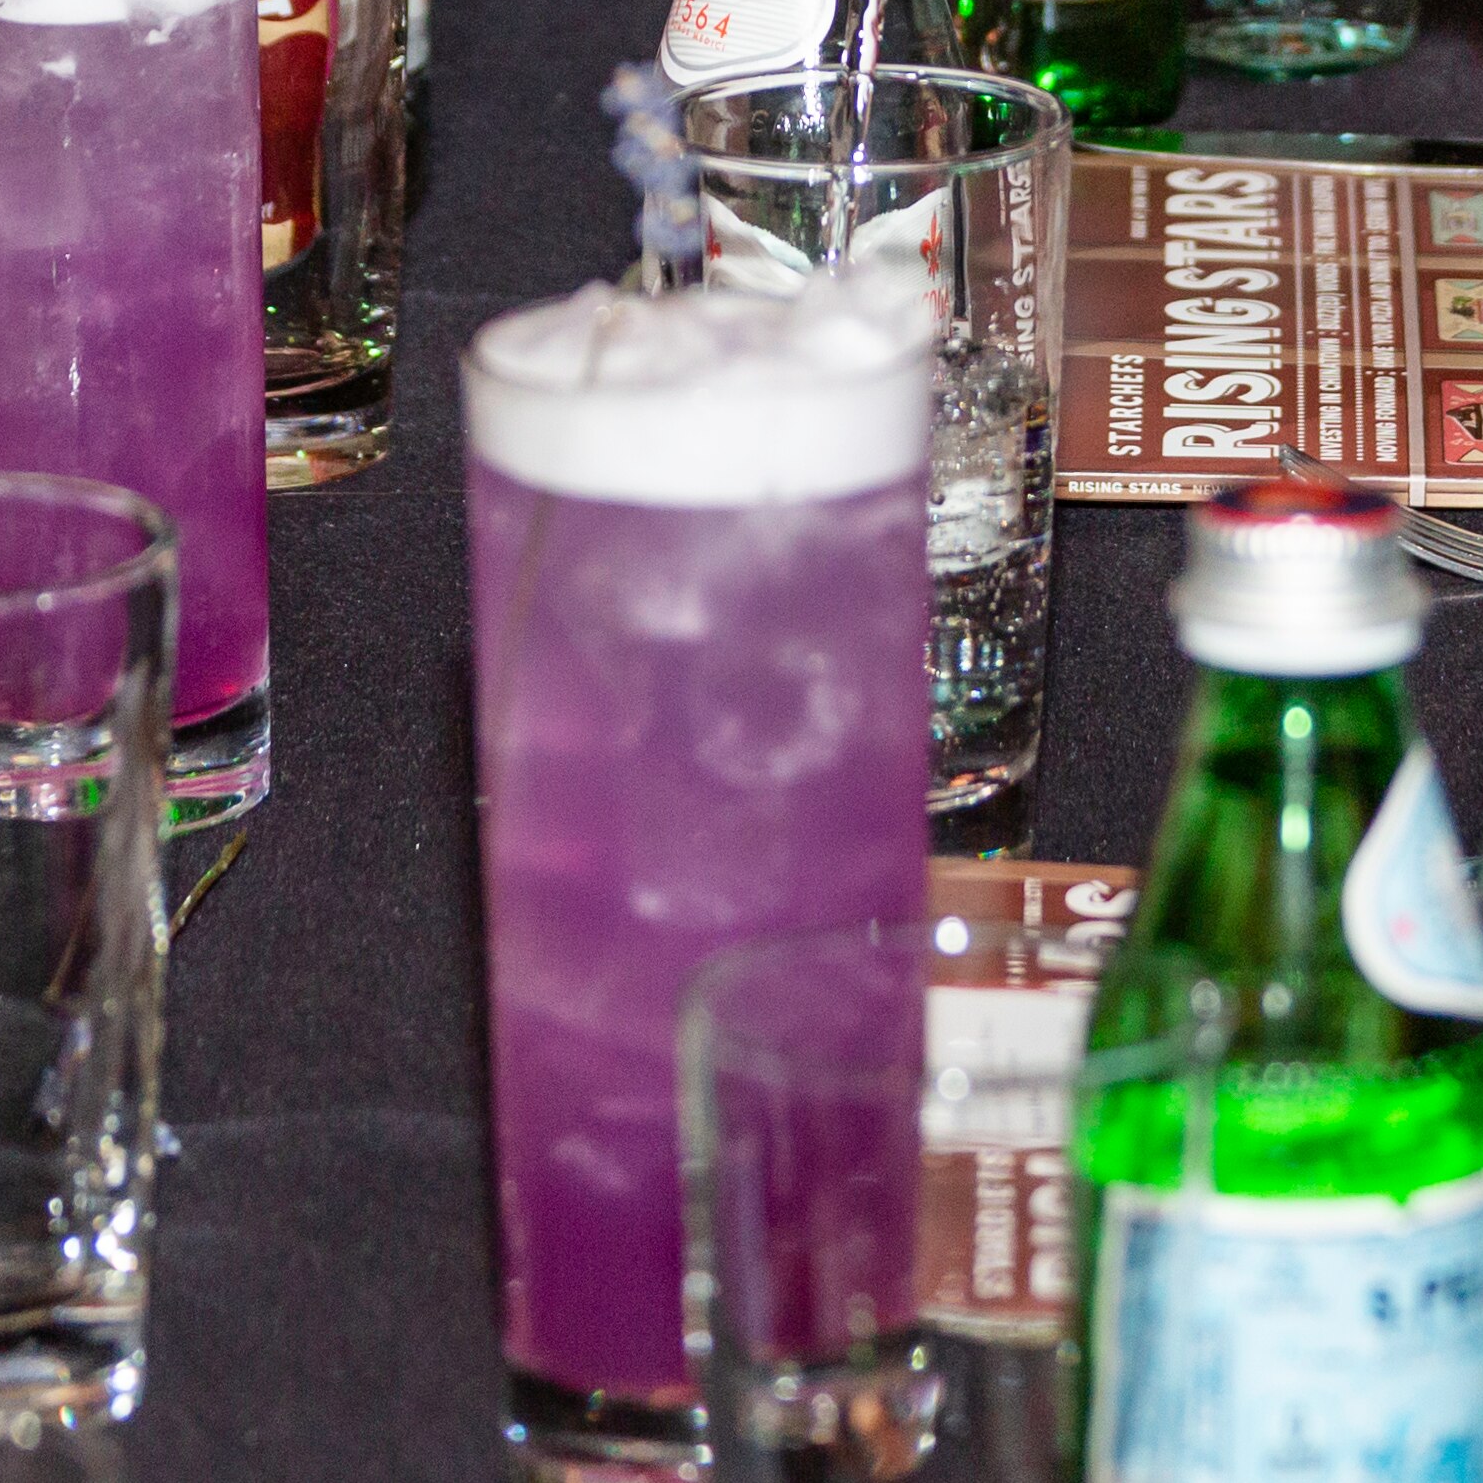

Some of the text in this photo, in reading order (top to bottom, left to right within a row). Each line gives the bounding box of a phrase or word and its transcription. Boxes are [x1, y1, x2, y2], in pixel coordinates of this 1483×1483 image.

[1161, 167, 1283, 459] RISING STARS
[1370, 301, 1394, 323] PIZZA
[1371, 324, 1394, 344] YOUR
[1316, 338, 1342, 391] CHINATOWN
[1372, 346, 1396, 368] HAVE
[1108, 354, 1145, 457] STARCHEFS
[1318, 392, 1342, 403] IN
[1373, 376, 1396, 420] FORWARD
[1318, 406, 1343, 460] INVESTING
[1374, 422, 1398, 462] MOVING
[1068, 481, 1123, 493] RISING
[1128, 483, 1181, 495] STARS
